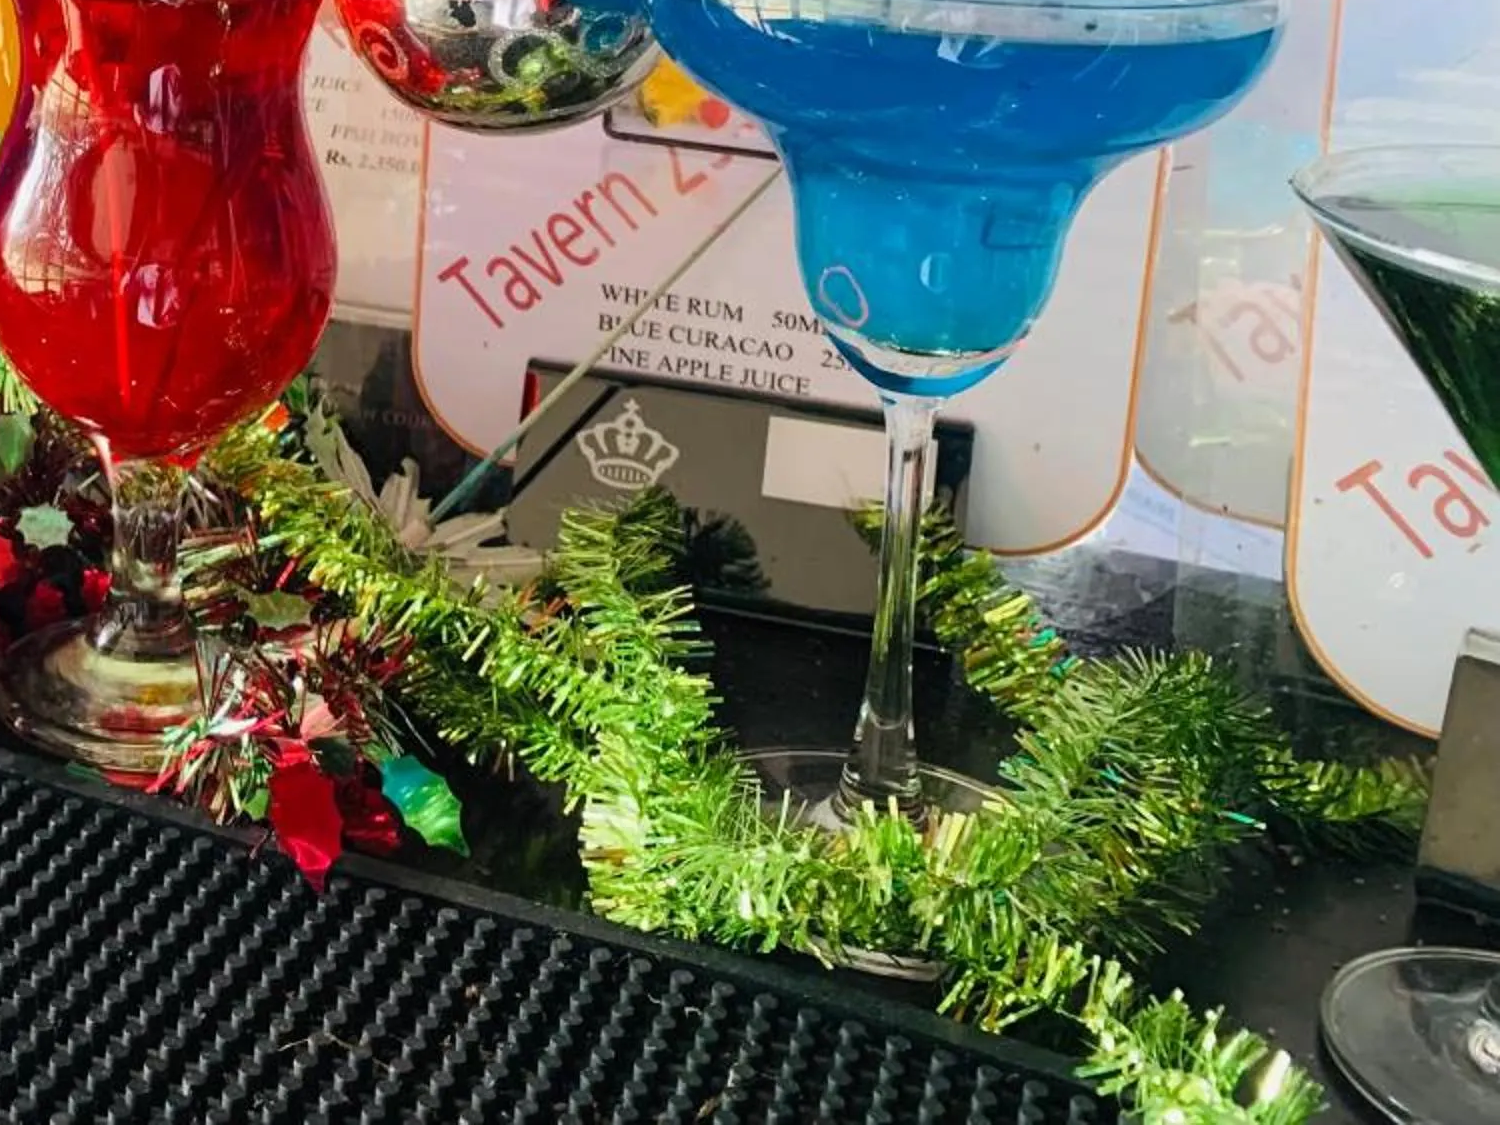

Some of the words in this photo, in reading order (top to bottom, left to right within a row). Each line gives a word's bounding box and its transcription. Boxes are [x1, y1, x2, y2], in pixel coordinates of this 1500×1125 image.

[437, 171, 659, 329] Tavern
[686, 296, 745, 324] RUM
[668, 325, 795, 362] CURACAO
[819, 349, 854, 372] 25
[656, 355, 734, 383] APPLE
[739, 367, 812, 396] JUICE
